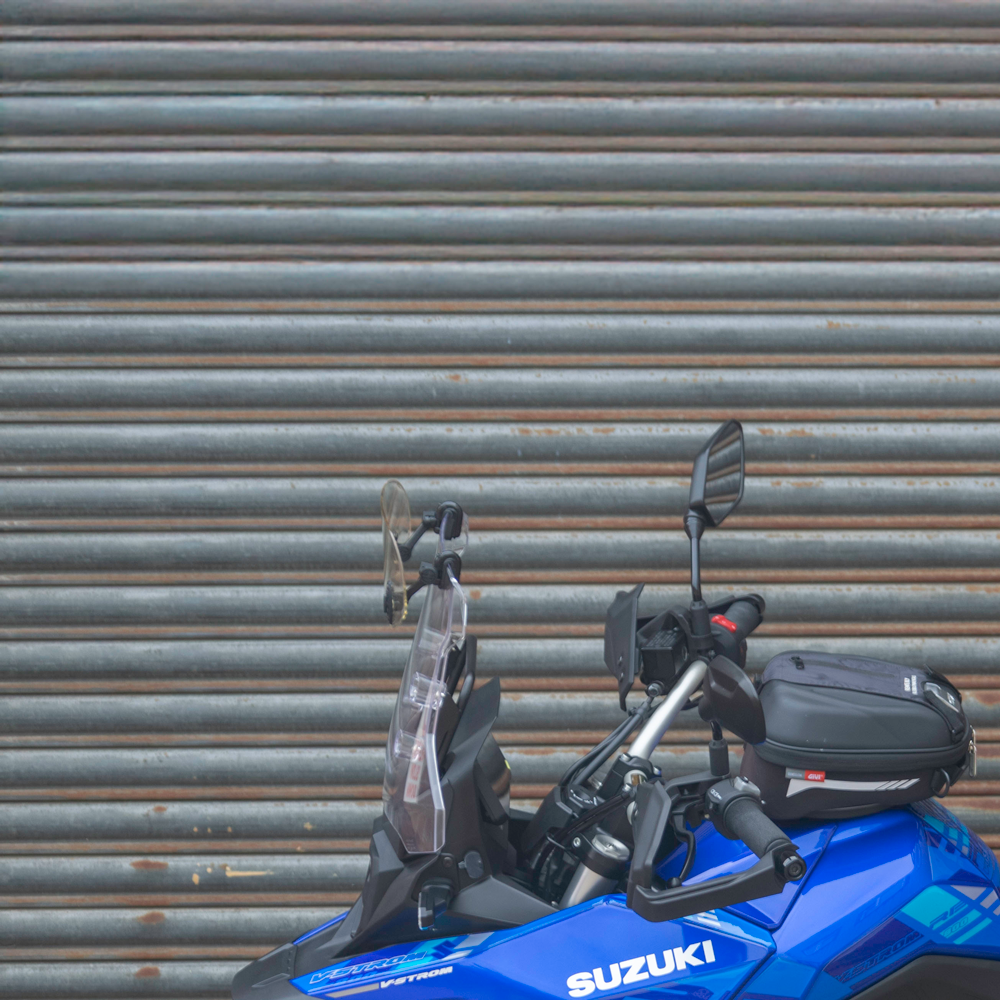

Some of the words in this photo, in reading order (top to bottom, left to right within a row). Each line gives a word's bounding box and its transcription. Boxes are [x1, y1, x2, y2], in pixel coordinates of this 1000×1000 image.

[807, 773, 821, 781] GIVI
[309, 951, 428, 985] V-STROM
[380, 966, 453, 989] V-STROM
[566, 939, 716, 998] SUZUKI
